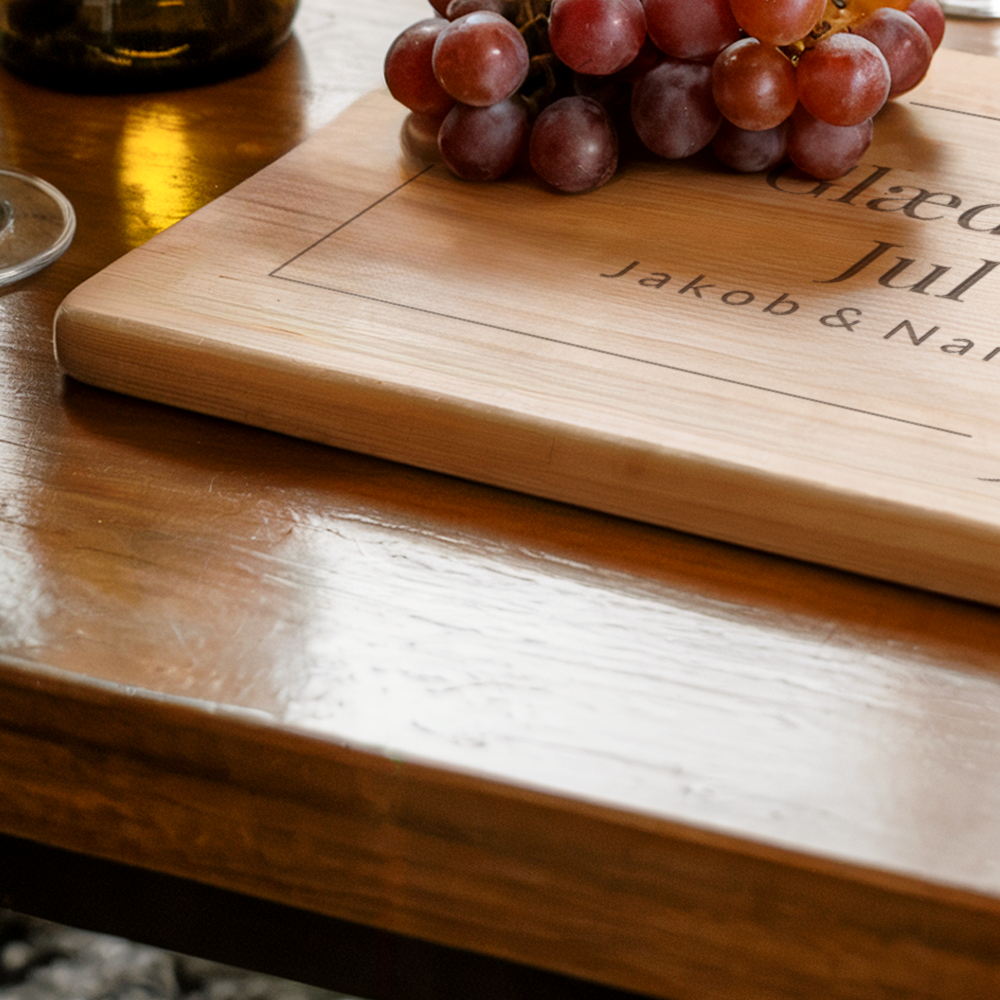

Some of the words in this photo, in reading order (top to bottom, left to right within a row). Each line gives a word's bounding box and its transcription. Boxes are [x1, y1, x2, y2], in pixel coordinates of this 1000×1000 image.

[601, 260, 800, 316] Jakob
[819, 307, 863, 331] &
[812, 240, 1000, 302] Jul
